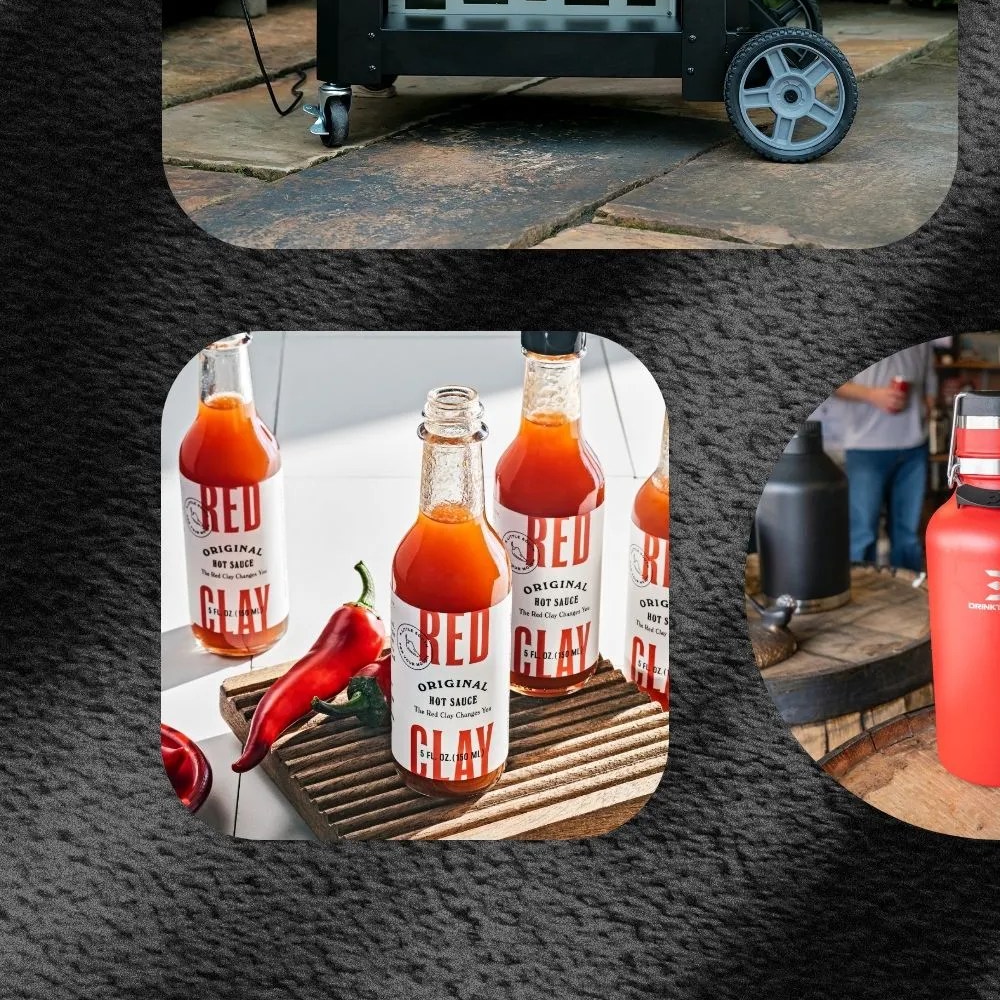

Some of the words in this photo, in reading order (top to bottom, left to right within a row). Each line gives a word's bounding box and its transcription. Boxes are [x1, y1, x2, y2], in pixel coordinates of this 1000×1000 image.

[200, 482, 261, 533] RED
[527, 511, 590, 567] RED
[202, 544, 263, 556] ORIGINAL
[212, 559, 227, 569] HOT
[230, 558, 254, 569] SAUCE
[523, 580, 588, 594] ORIGINAL
[534, 597, 551, 607] HOT
[554, 595, 579, 607] SAUCE
[199, 583, 270, 634] CLAY
[518, 608, 530, 616] The
[558, 609, 580, 618] Changes
[647, 611, 661, 624] HOT
[420, 608, 490, 666] RED
[514, 621, 591, 677] CLAY
[523, 649, 528, 657] 5
[417, 679, 488, 692] ORIGINAL
[429, 696, 447, 707] HOT
[450, 695, 478, 707] SAUCE
[414, 705, 425, 714] The
[426, 709, 438, 717] Red
[440, 711, 454, 719] Clay
[455, 710, 481, 719] Changes
[411, 722, 494, 781] CLAY
[420, 750, 425, 758] 5
[440, 753, 452, 762] OZ.
